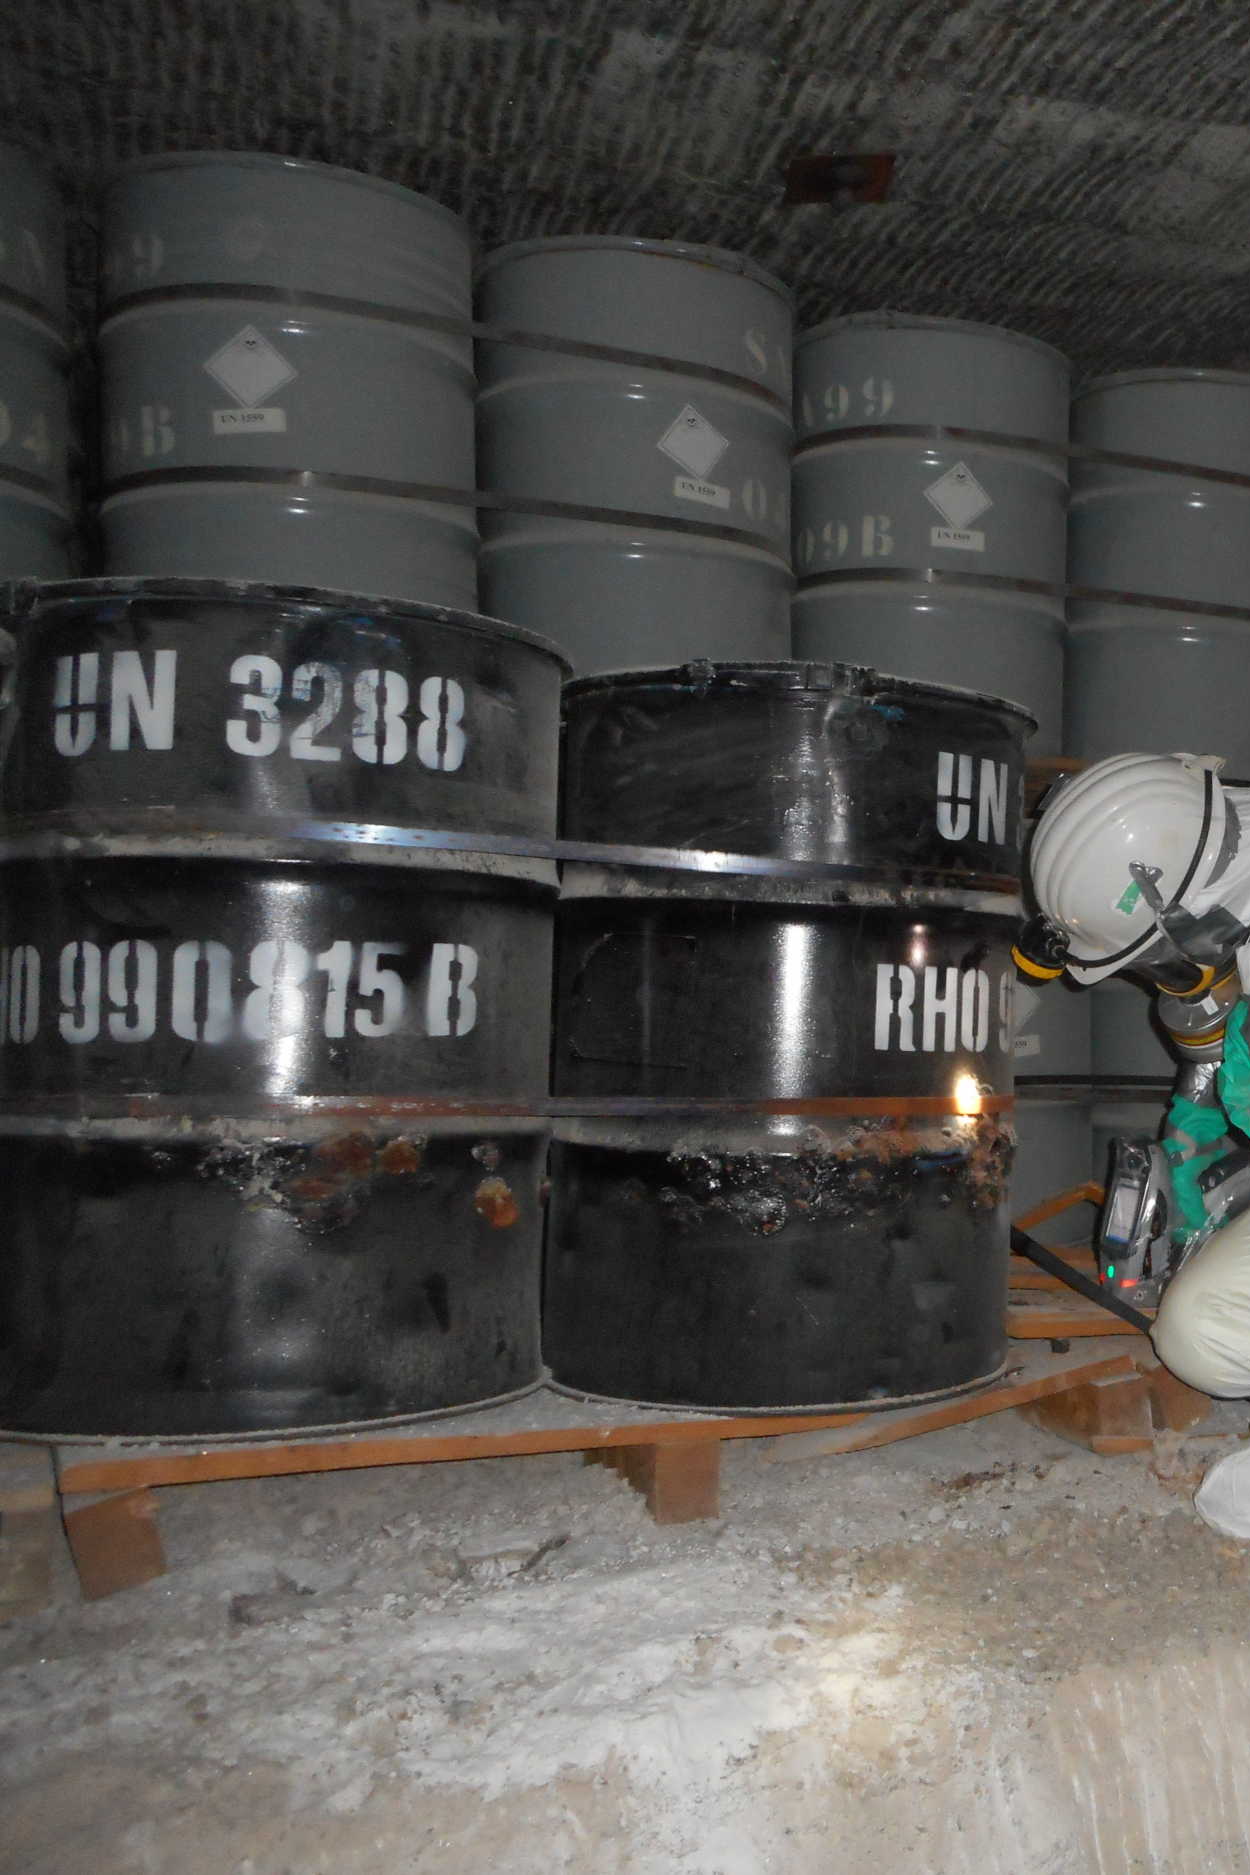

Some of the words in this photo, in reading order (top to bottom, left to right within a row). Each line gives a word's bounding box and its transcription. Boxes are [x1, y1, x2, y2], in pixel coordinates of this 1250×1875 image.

[53, 650, 177, 757] UN
[226, 654, 466, 772] 3288
[936, 751, 1008, 846] UN
[58, 939, 404, 1045] 990815
[427, 943, 478, 1037] B
